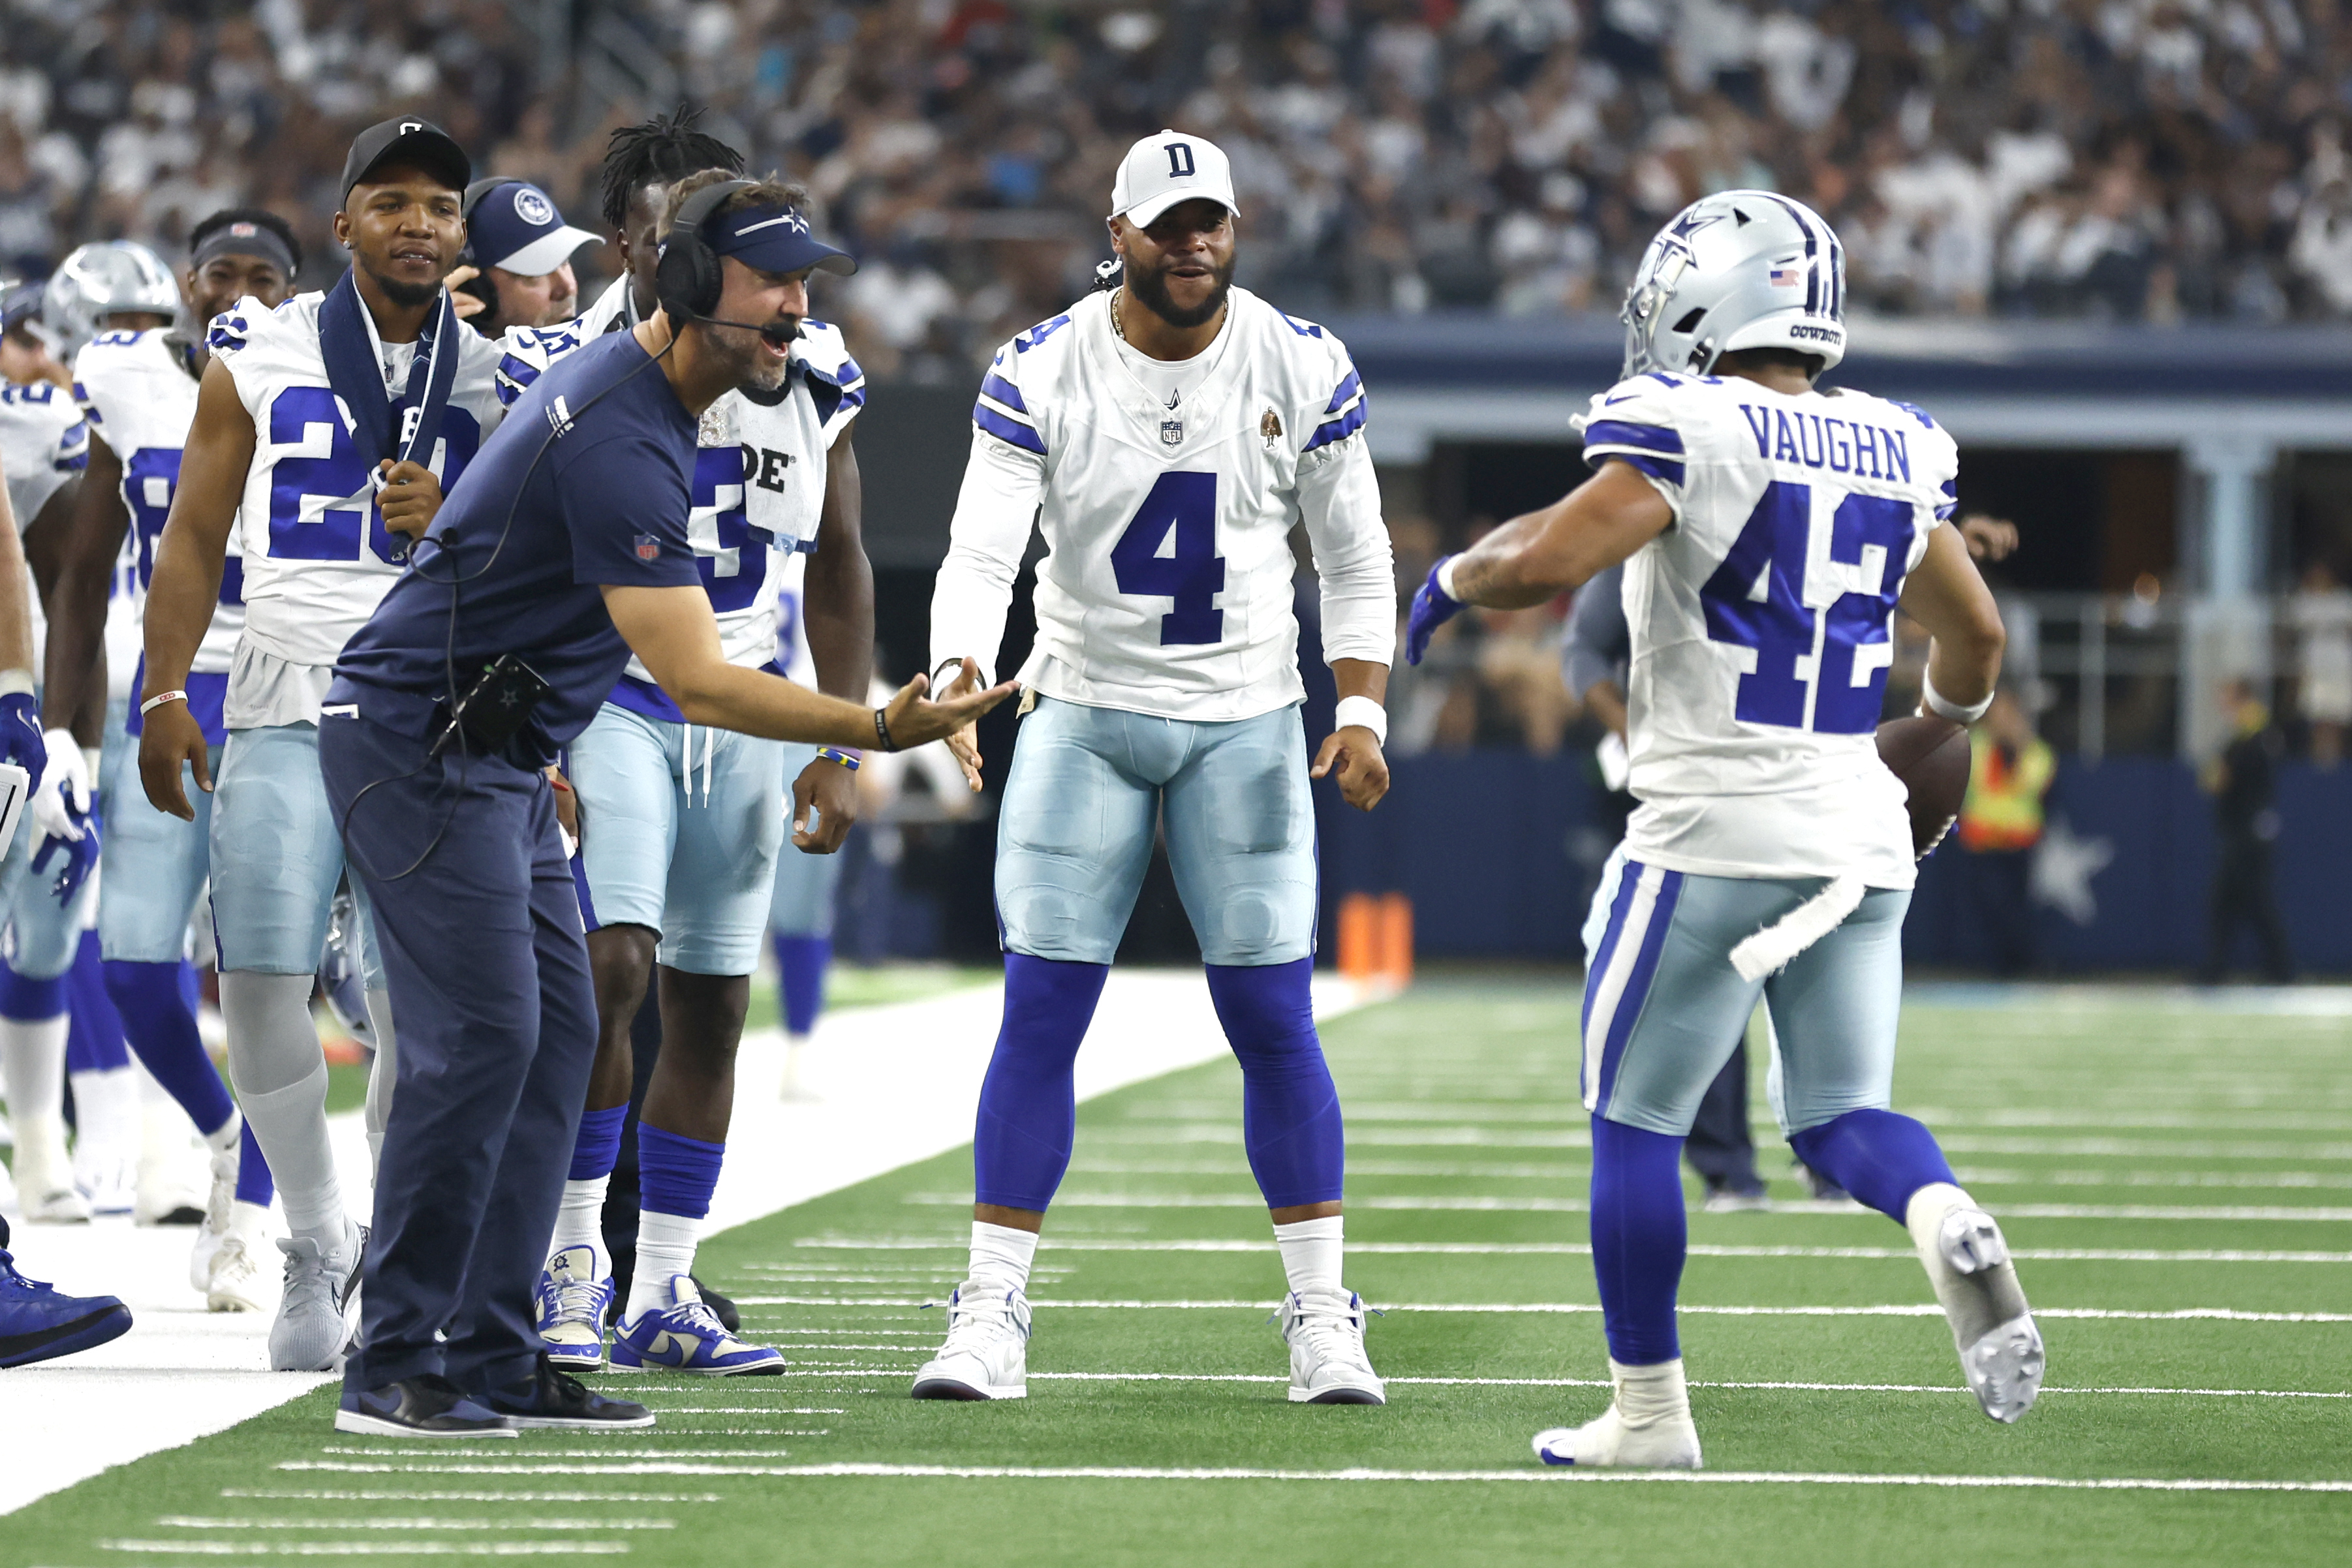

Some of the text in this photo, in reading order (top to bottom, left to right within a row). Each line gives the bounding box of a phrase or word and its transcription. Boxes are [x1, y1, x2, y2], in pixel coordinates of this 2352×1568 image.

[1164, 143, 1196, 178] D
[1015, 315, 1071, 354] 4
[1164, 431, 1180, 441] NFL
[1739, 404, 1911, 484] VAUGHN
[1110, 470, 1226, 646] 4
[1699, 480, 1915, 735] 42
